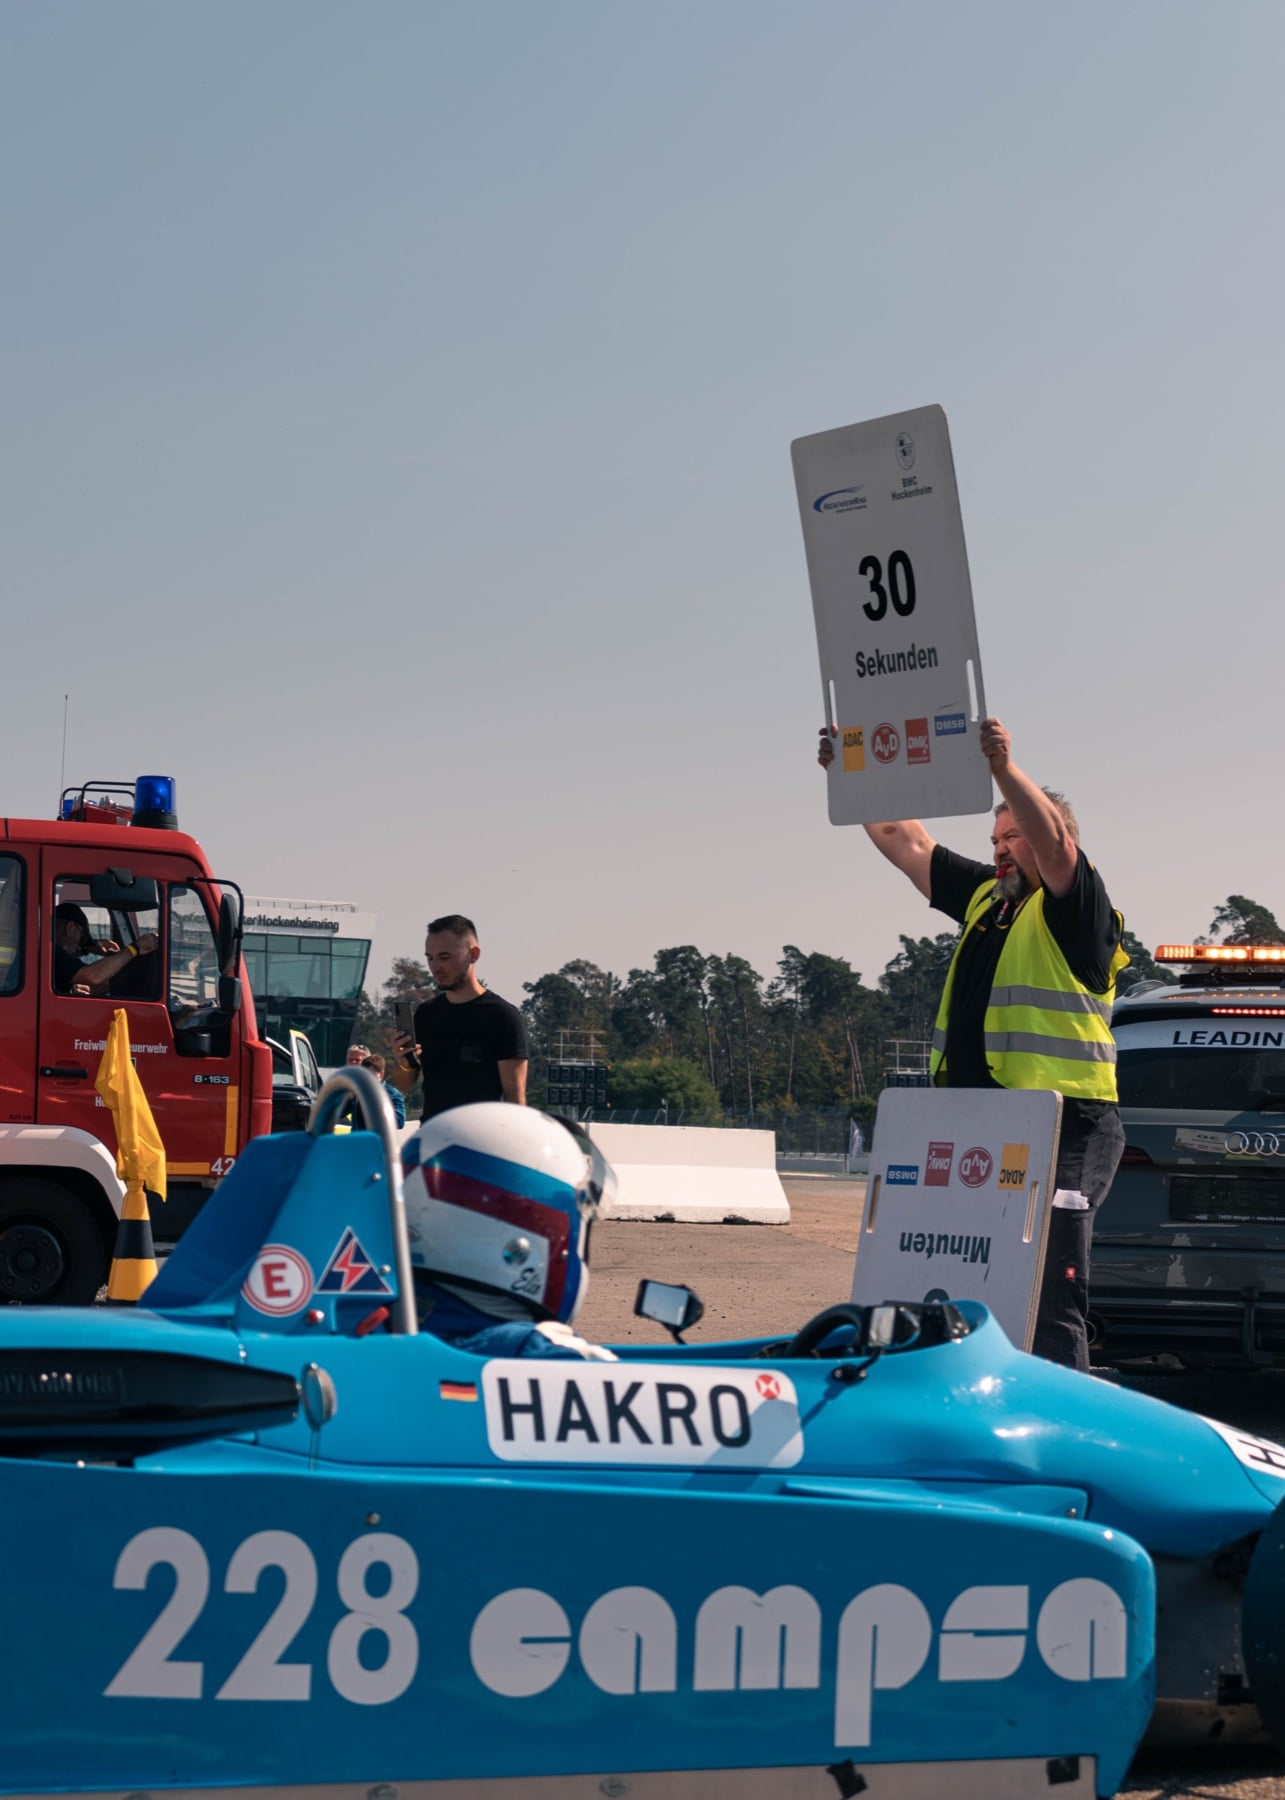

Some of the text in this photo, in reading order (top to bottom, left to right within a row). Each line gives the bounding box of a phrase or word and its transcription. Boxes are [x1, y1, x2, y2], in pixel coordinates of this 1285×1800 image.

[858, 550, 916, 622] 30
[855, 643, 939, 678] Sekunden
[936, 719, 965, 731] DMSB
[843, 731, 863, 748] ADAC
[258, 914, 340, 932] Hockenheimring
[74, 1039, 168, 1054] Freiwill euerwehr
[1172, 1030, 1284, 1047] LEADIN
[888, 1170, 917, 1180] DMSB
[1000, 1168, 1026, 1185] ADAC
[899, 1232, 991, 1264] Minuten
[261, 1262, 291, 1299] E
[496, 1377, 751, 1449] HAKRO
[102, 1526, 420, 1705] 228
